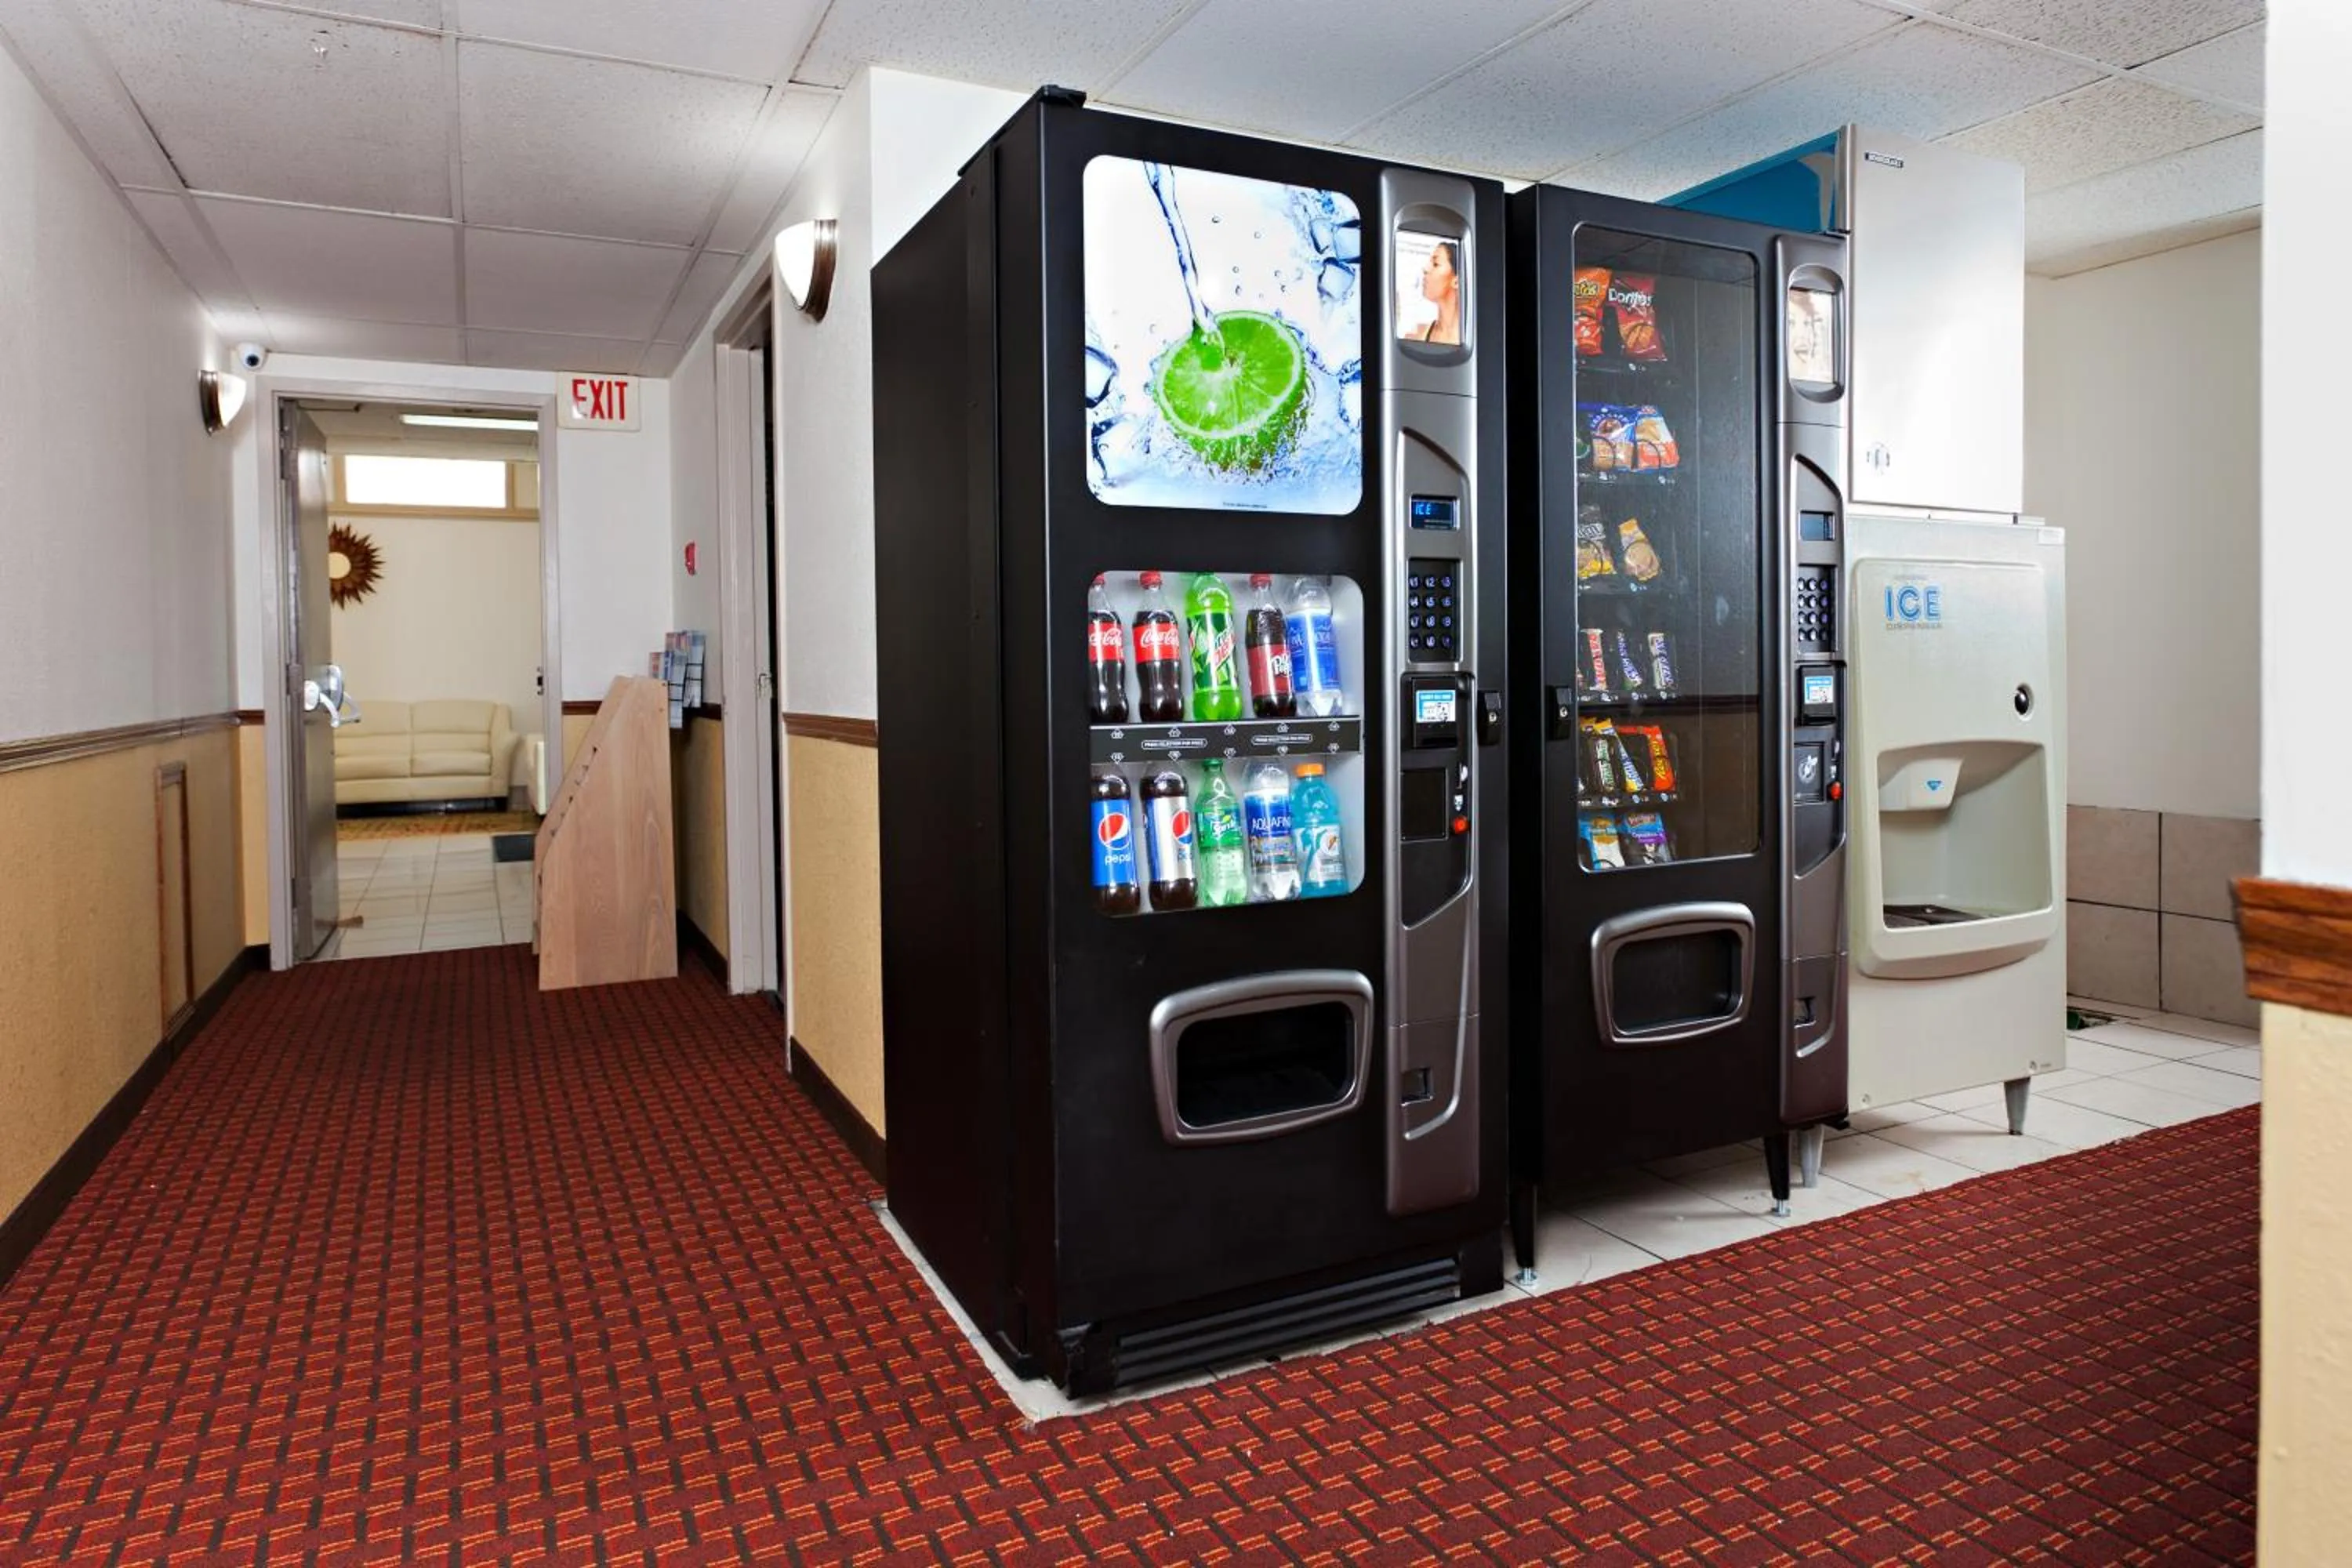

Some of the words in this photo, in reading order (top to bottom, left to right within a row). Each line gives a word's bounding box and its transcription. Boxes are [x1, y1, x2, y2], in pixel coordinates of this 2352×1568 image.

[1608, 288, 1653, 309] Doritos
[572, 378, 629, 421] EXIT
[1415, 503, 1432, 516] ICE
[1884, 586, 1941, 622] ICE
